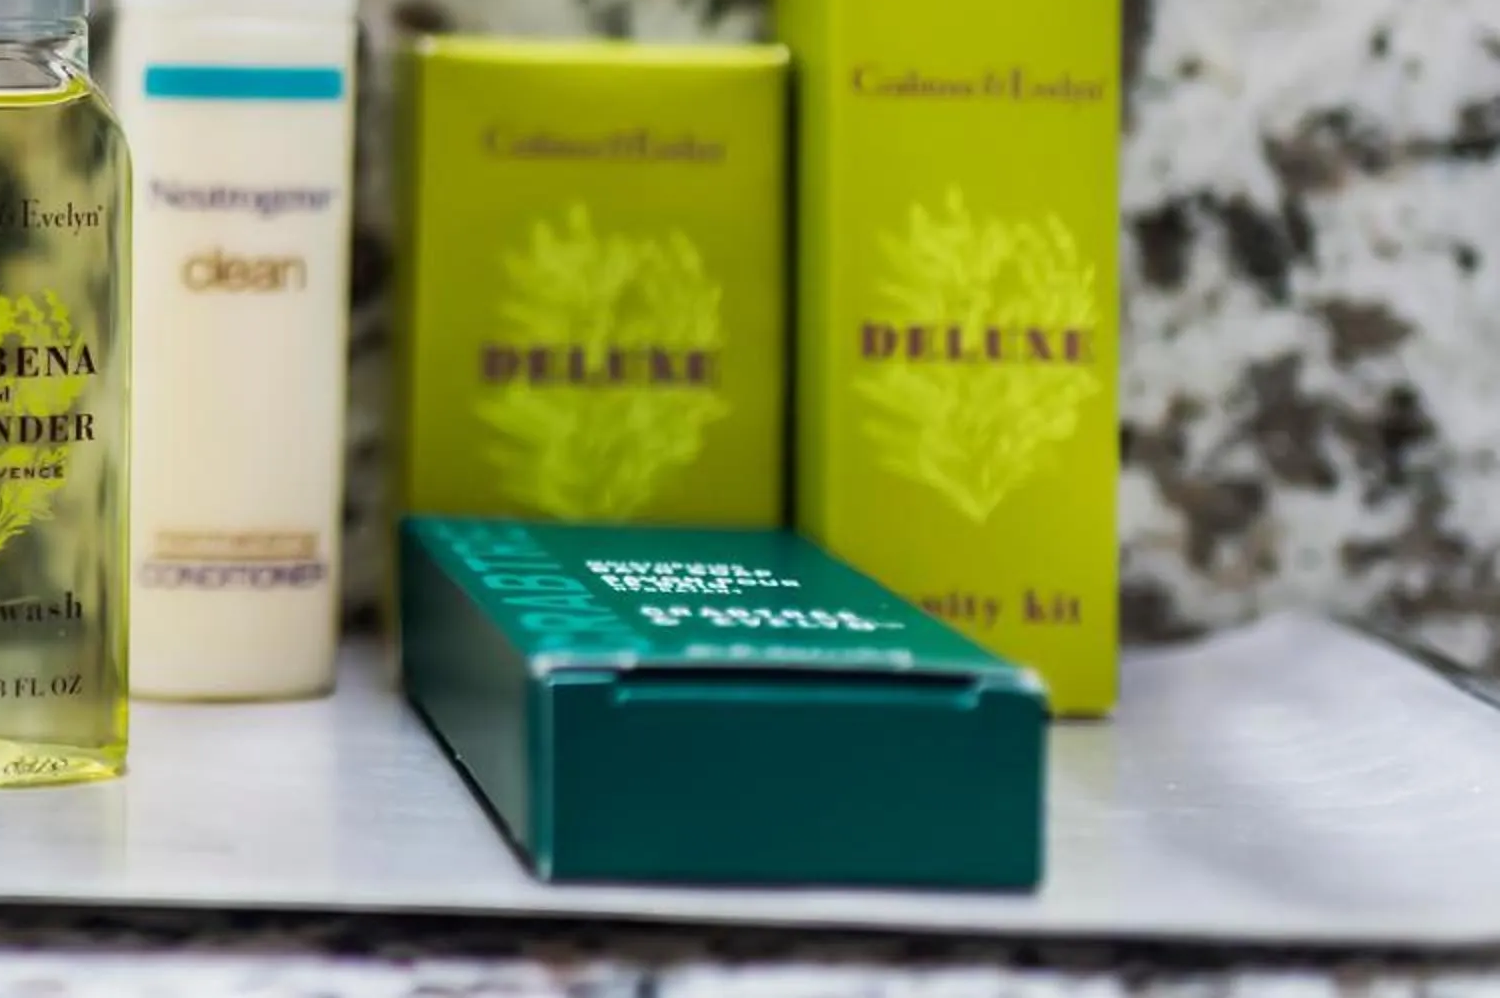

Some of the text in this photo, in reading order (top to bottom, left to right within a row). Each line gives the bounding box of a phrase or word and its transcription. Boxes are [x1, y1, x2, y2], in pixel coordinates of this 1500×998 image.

[179, 247, 308, 294] clean
[861, 321, 1097, 362] DELUXE
[480, 341, 722, 390] DELUXE
[1023, 587, 1082, 624] kit
